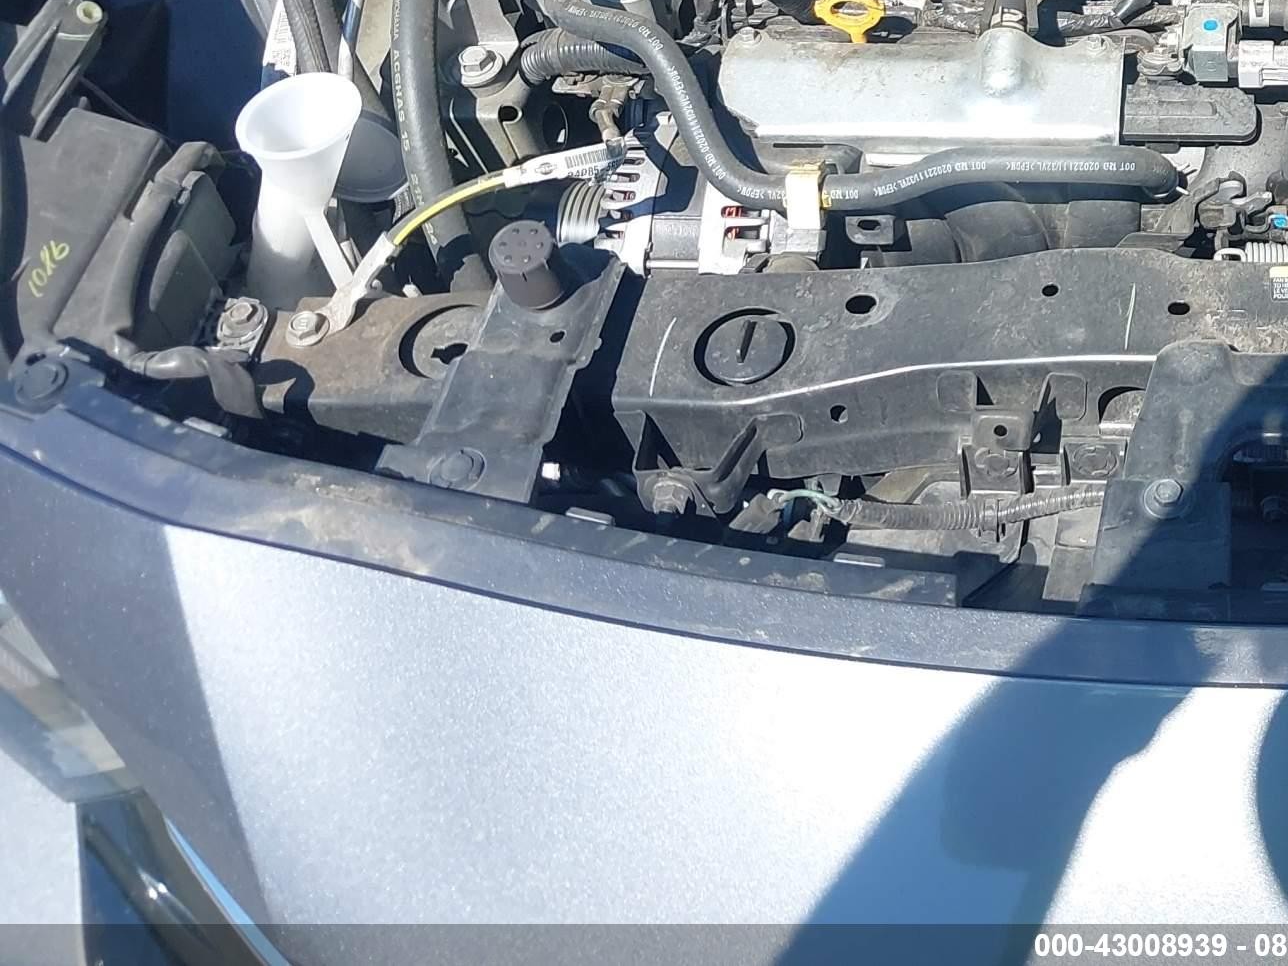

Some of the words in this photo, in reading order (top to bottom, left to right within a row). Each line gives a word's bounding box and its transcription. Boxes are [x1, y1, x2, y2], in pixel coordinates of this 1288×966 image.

[971, 161, 987, 171] DOT
[1119, 161, 1136, 171] DOT
[845, 189, 859, 200] DOT
